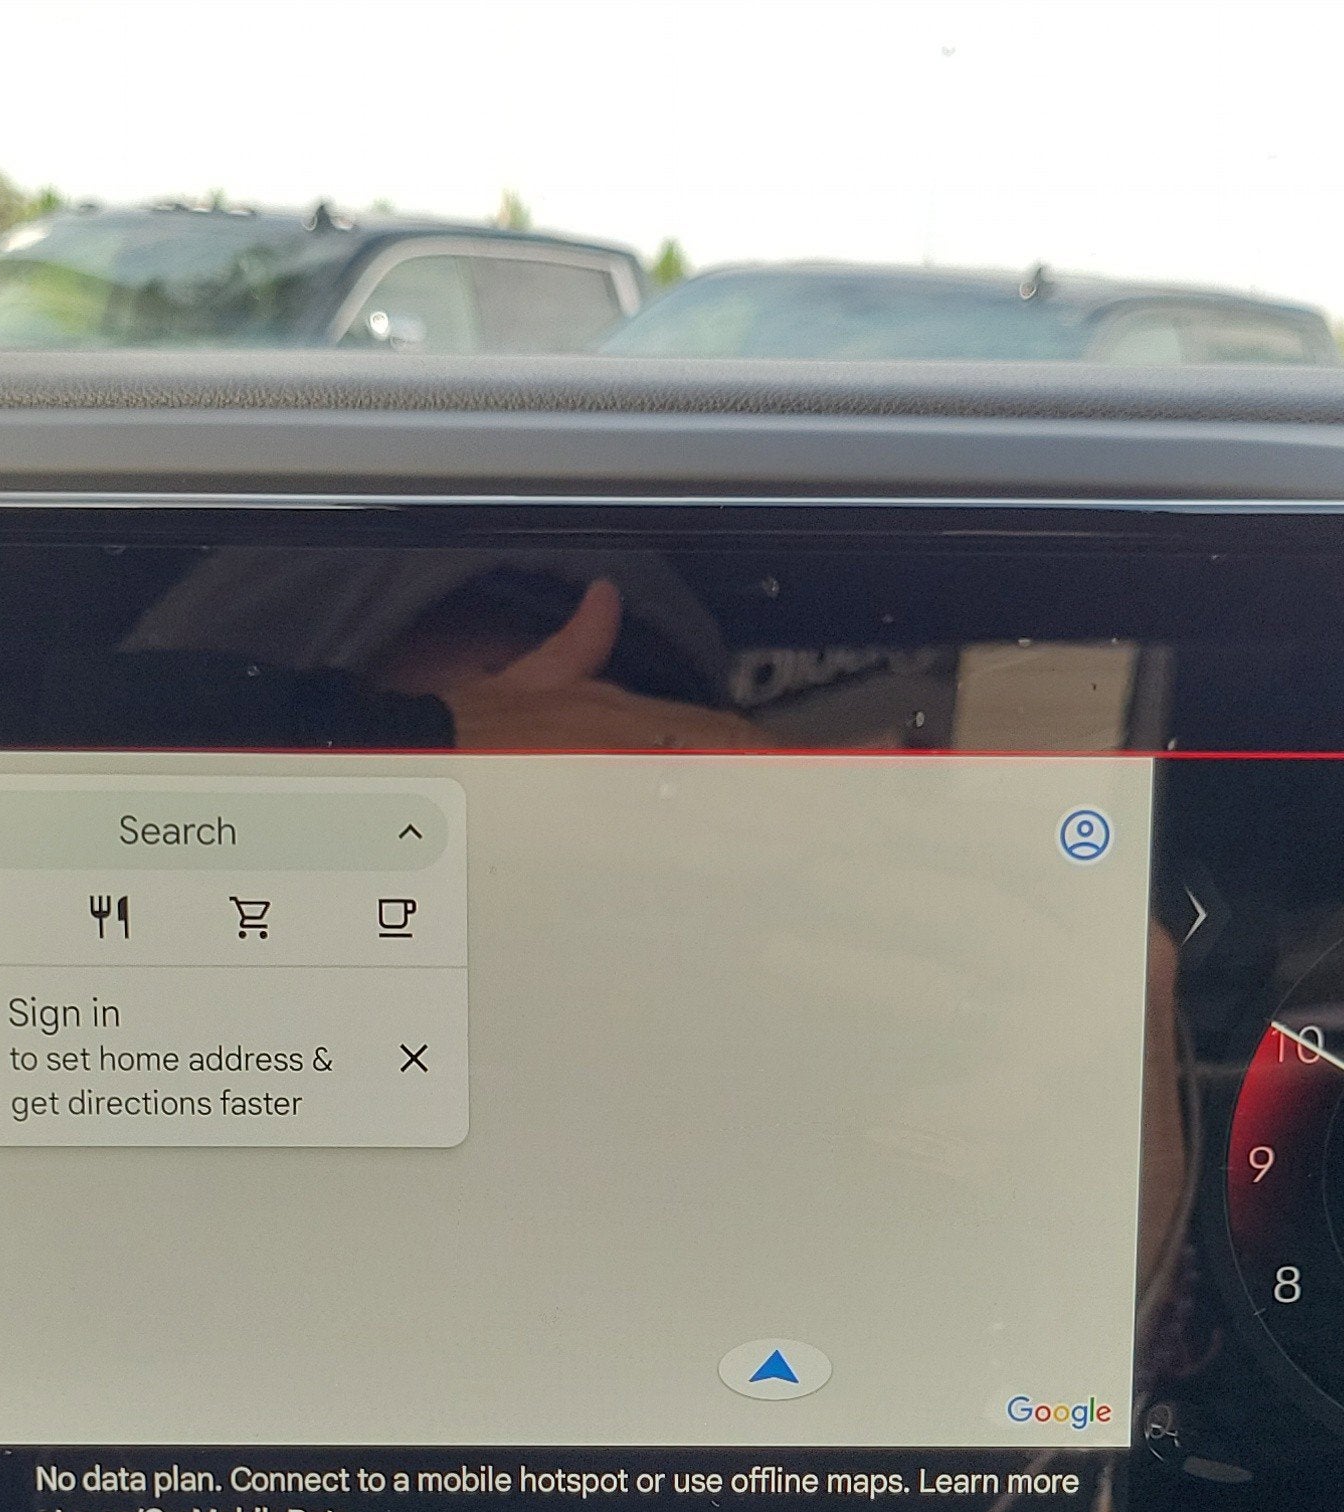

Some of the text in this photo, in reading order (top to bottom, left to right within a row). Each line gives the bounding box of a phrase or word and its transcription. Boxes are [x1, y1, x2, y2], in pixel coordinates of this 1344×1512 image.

[119, 814, 236, 846] Search
[9, 996, 120, 1033] Sign in
[9, 1044, 333, 1072] to set home address &
[1272, 1025, 1326, 1064] 10
[11, 1088, 303, 1122] get directions faster
[1248, 1146, 1275, 1183] 9
[1273, 1266, 1301, 1303] 8
[1007, 1395, 1112, 1430] Google
[36, 1464, 1080, 1500] No data plan. Connect to a mobile hotspot or use offline maps. Learn more
